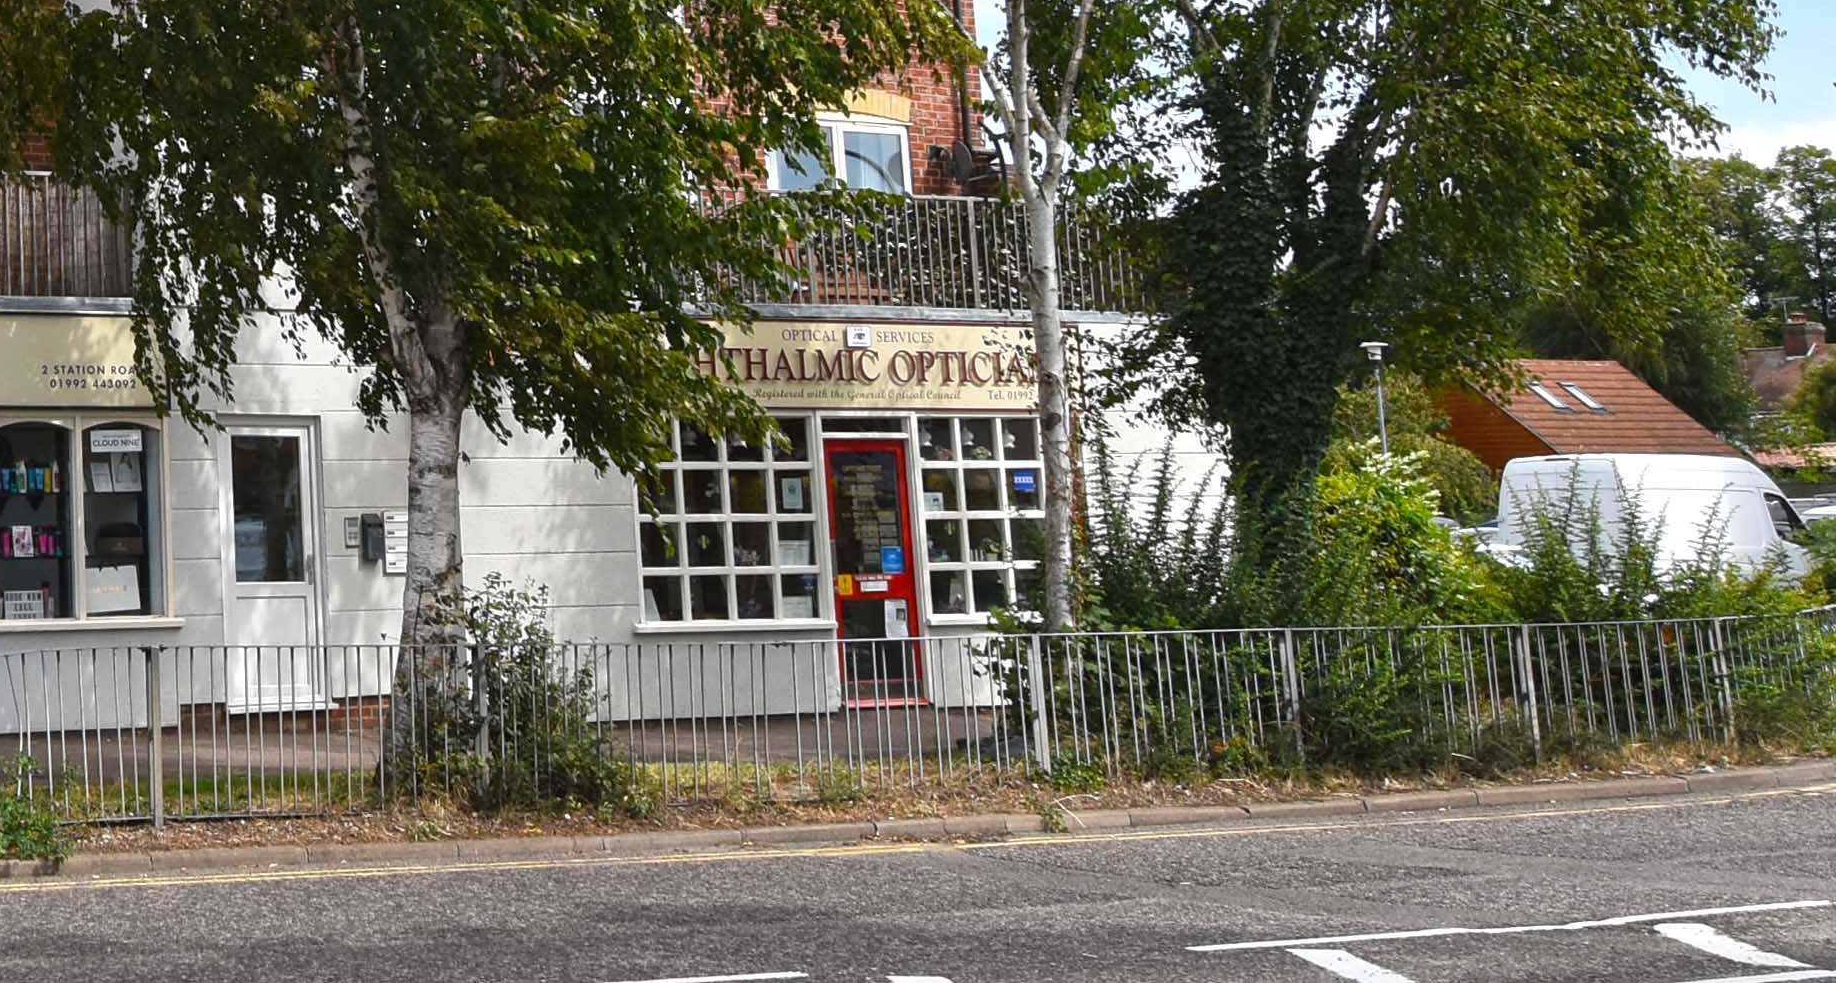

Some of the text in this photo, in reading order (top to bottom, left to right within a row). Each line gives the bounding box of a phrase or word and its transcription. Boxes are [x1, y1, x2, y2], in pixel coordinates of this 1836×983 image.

[781, 328, 934, 344] OPTICAL SERVICES
[41, 365, 138, 375] 2 STATION ROA
[694, 347, 1041, 385] HTHALMIC OPTICIA
[49, 378, 137, 389] 01992 443092
